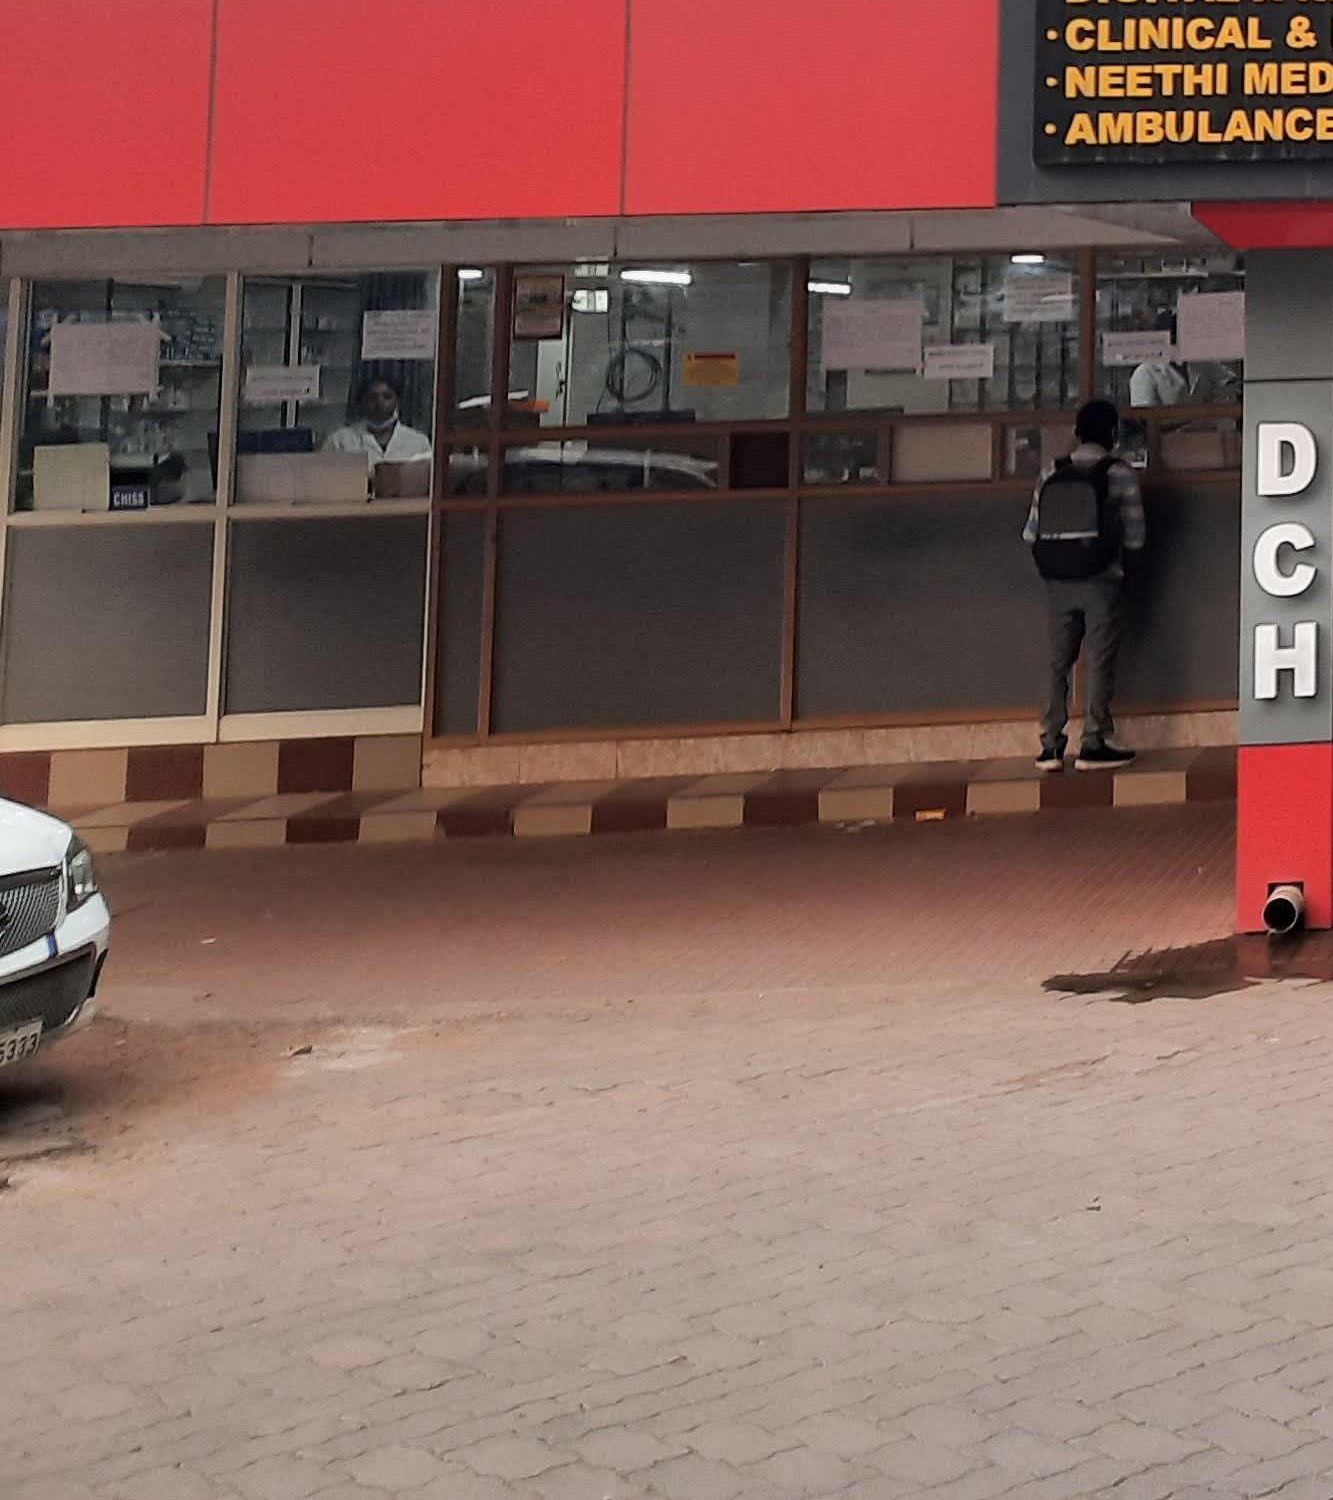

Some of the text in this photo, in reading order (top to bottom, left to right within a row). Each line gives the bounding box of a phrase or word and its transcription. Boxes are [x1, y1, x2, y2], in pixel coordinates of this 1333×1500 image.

[1065, 17, 1272, 51] CLINICAL
[1286, 15, 1317, 49] &
[1065, 63, 1228, 98] NEETHI
